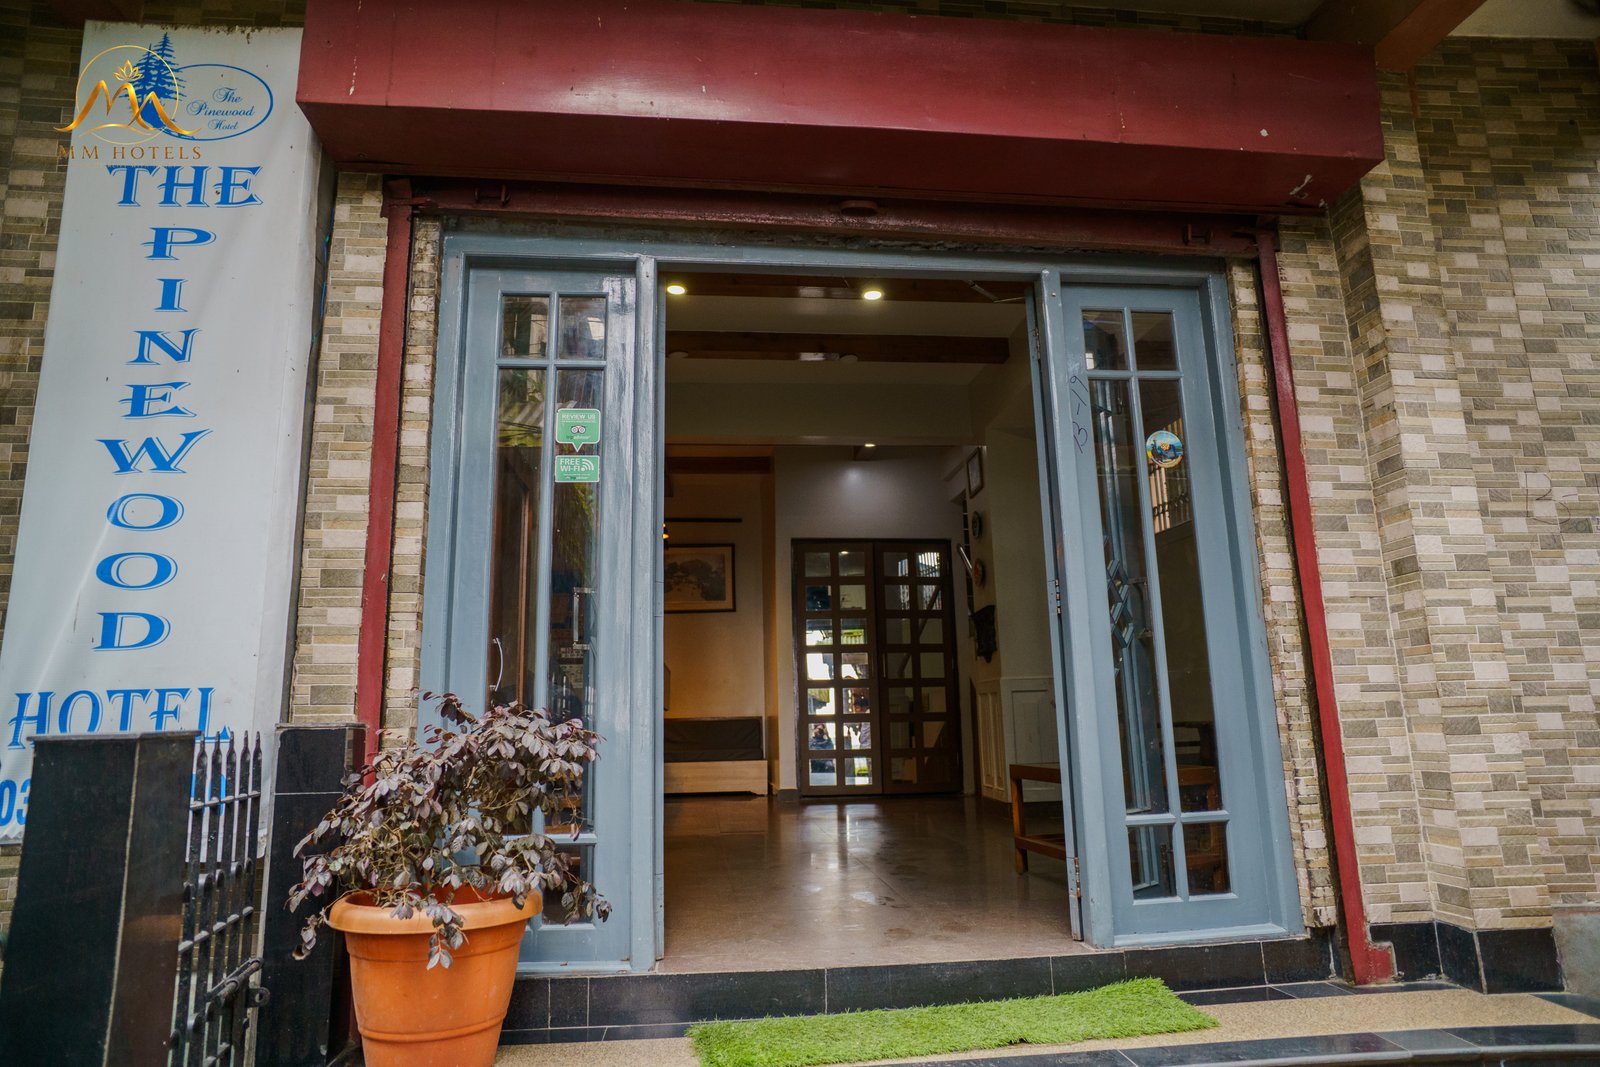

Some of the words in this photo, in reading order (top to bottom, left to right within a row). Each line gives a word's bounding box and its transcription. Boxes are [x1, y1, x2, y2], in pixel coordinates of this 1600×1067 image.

[212, 87, 243, 103] The
[186, 100, 255, 117] Pinewood
[207, 119, 238, 130] Hotel
[105, 164, 264, 208] THE
[8, 687, 231, 750] HOTEL
